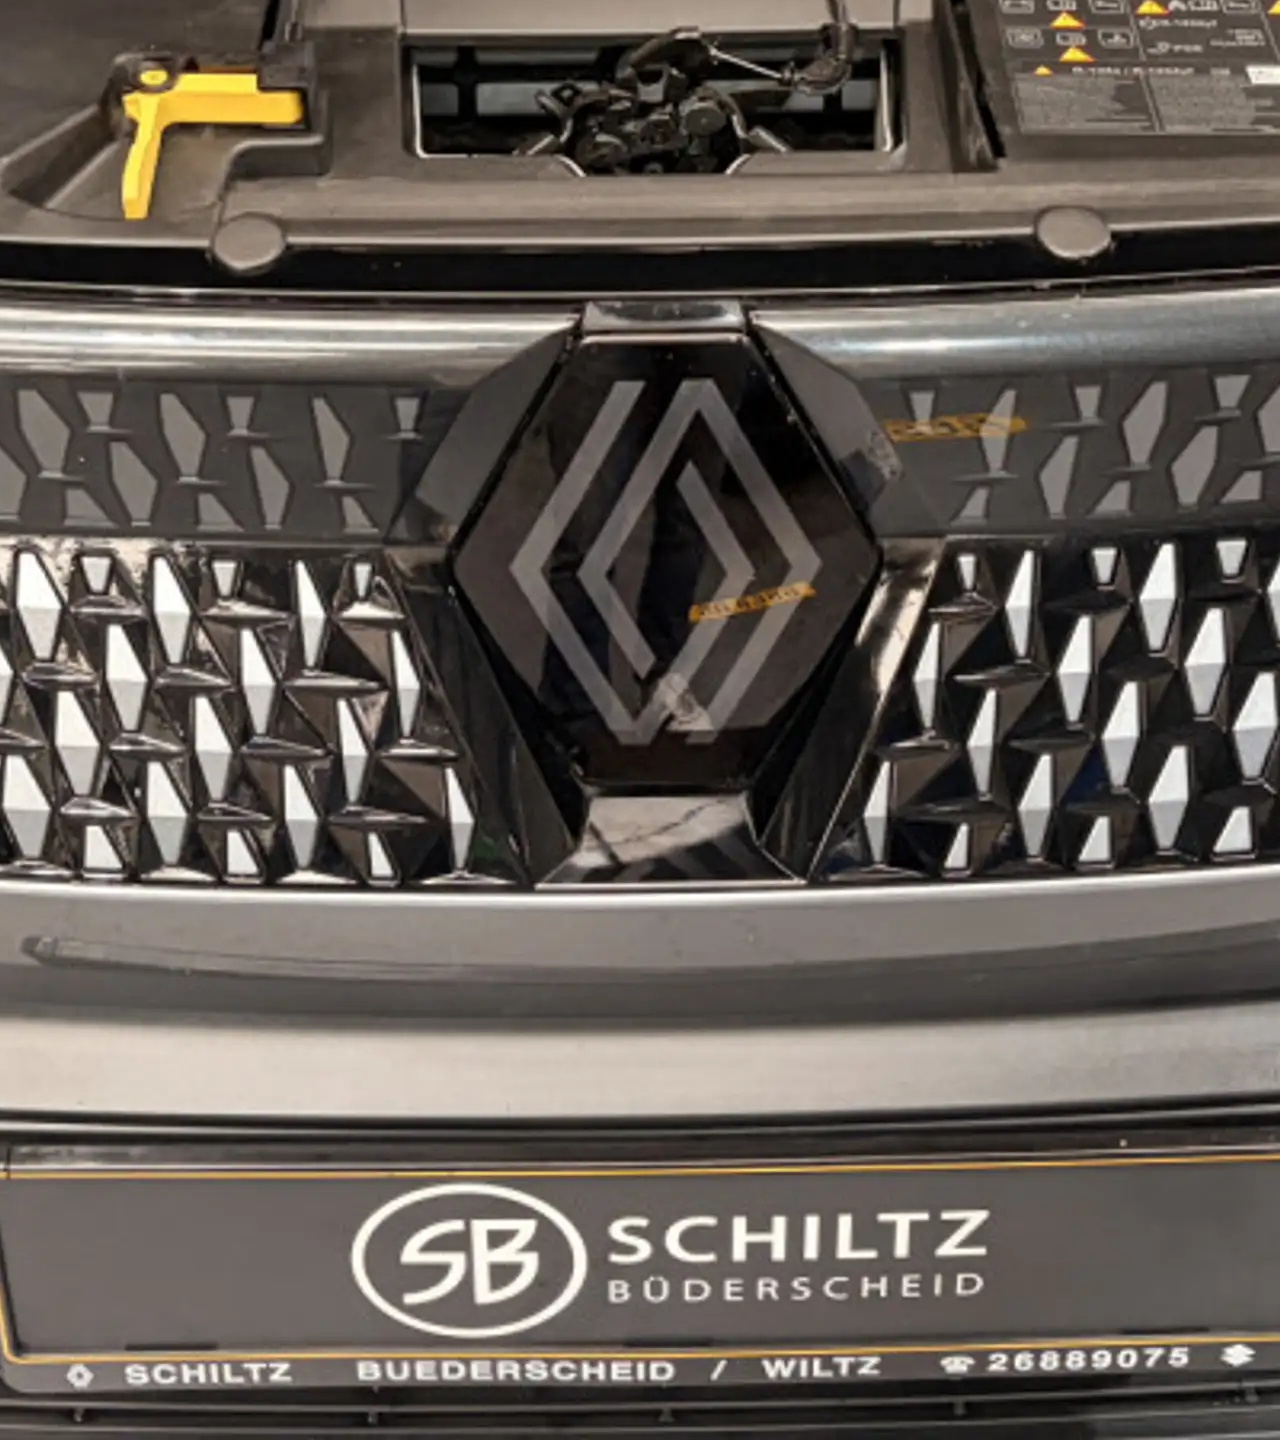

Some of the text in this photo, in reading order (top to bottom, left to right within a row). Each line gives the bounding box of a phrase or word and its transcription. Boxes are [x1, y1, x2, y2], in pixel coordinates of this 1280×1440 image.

[606, 1209, 991, 1264] SCHILTZ
[399, 1217, 540, 1306] SB
[606, 1272, 985, 1304] BÜDERSCHEID
[123, 1346, 1190, 1386] SCHILTZ BUEDERSCHEID / WILTZ 26889075
